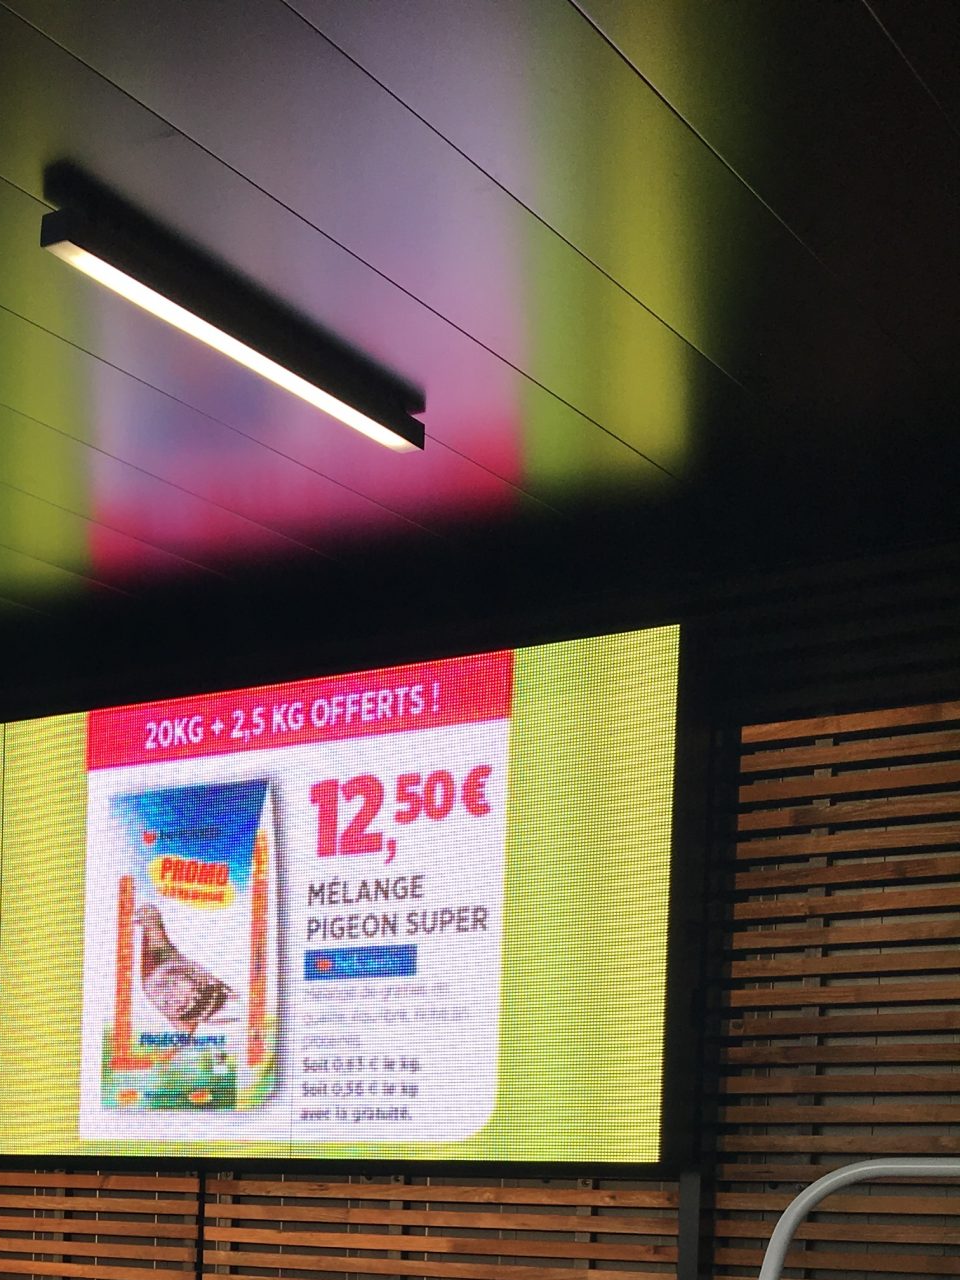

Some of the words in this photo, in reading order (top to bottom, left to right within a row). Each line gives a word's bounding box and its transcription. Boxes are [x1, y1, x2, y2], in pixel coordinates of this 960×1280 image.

[145, 716, 204, 749] 20KG
[211, 717, 224, 736] +
[231, 707, 264, 741] 2,5
[272, 703, 305, 732] KG
[310, 684, 426, 727] OFFERTS
[433, 682, 440, 712] !
[160, 856, 229, 887] PROMO
[308, 874, 424, 907] MÉLANGE
[307, 911, 398, 942] PIGEON
[406, 905, 488, 936] SUPER
